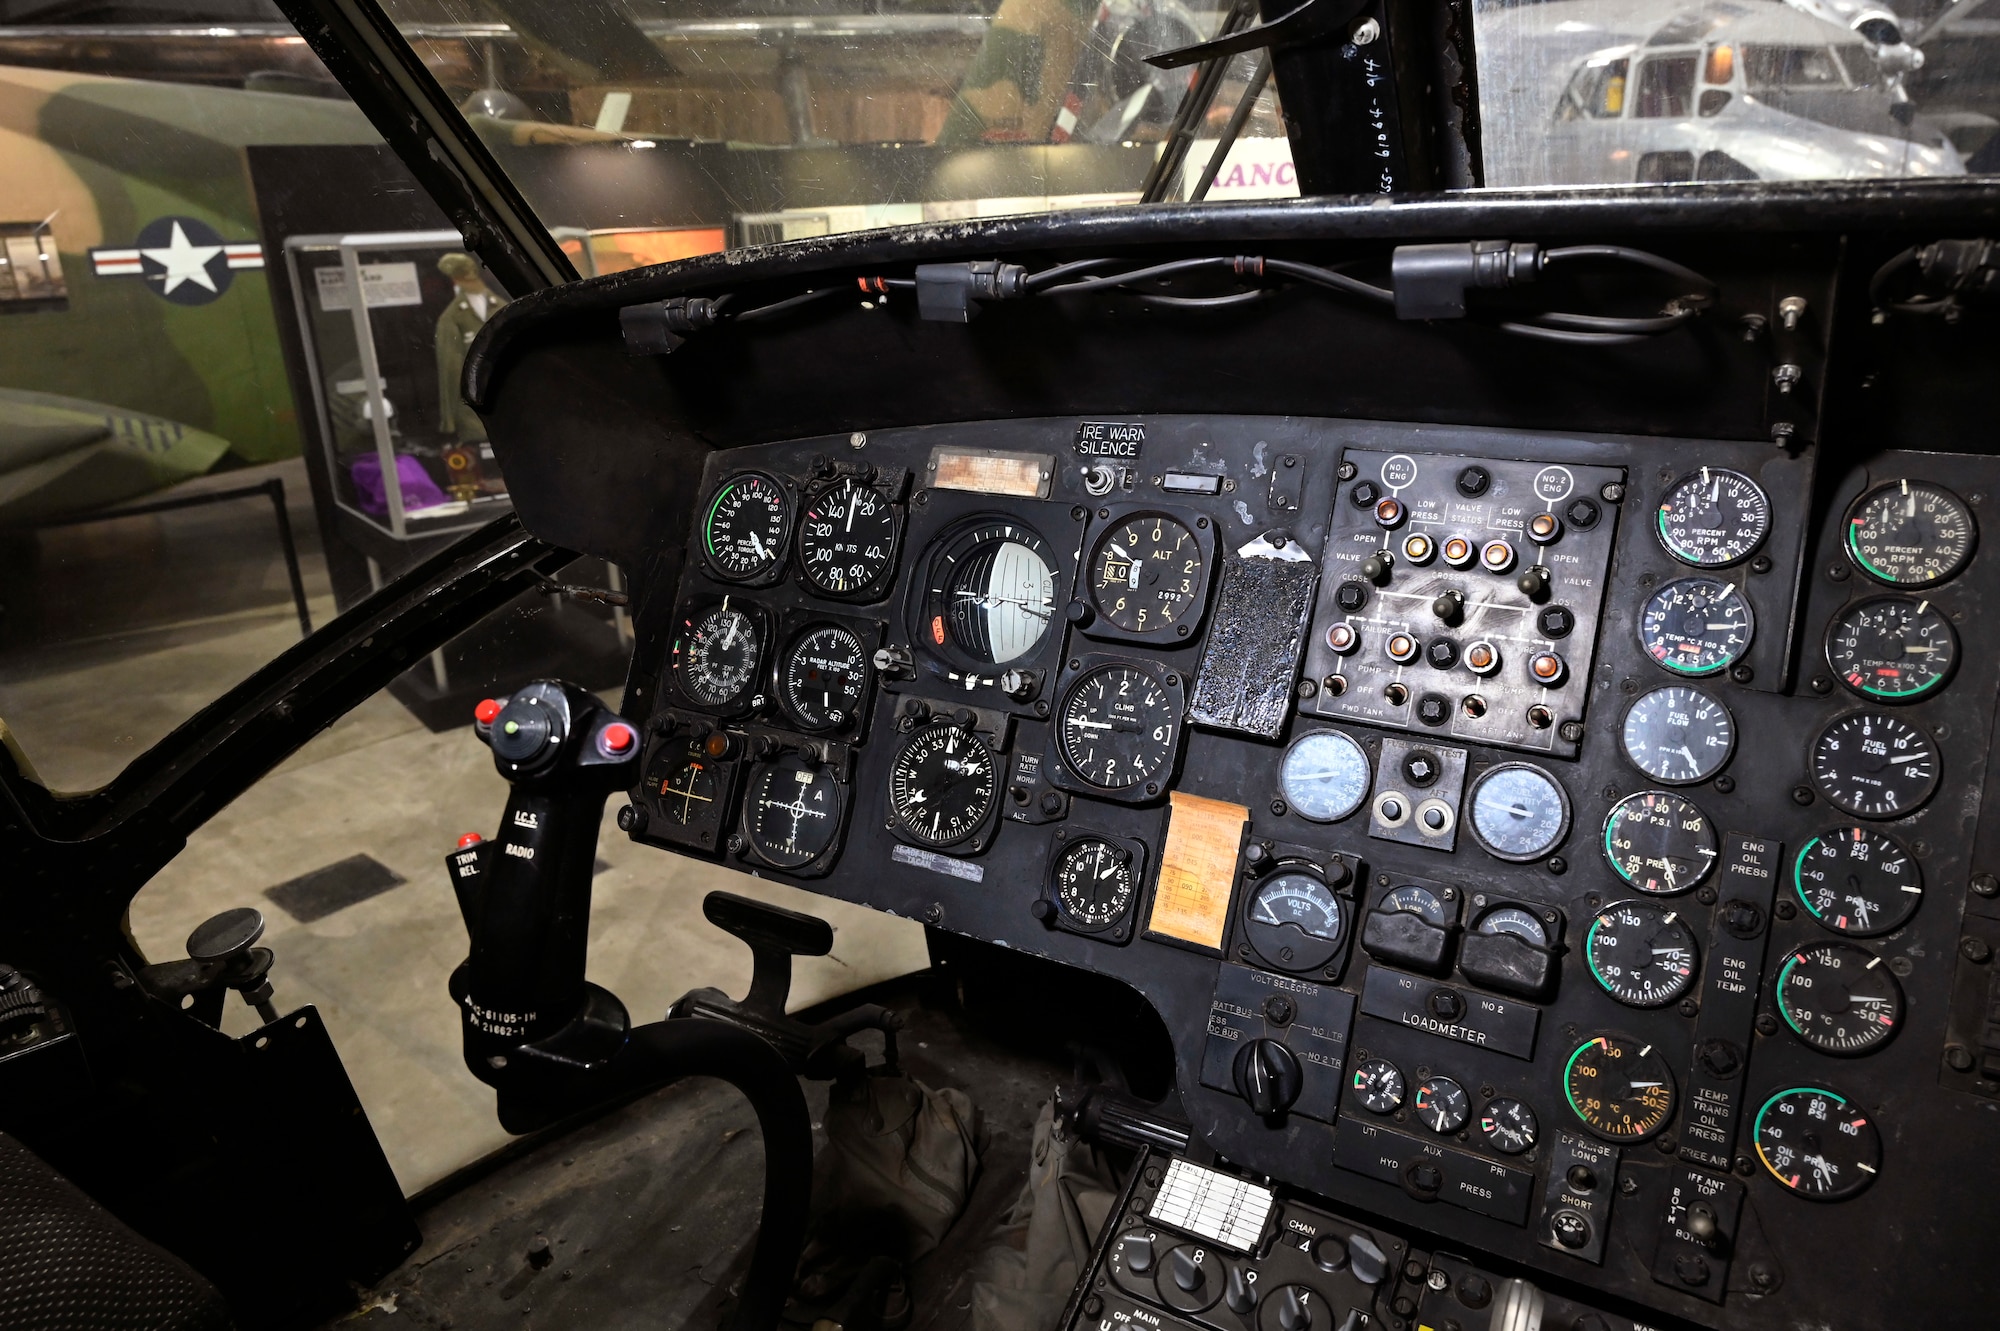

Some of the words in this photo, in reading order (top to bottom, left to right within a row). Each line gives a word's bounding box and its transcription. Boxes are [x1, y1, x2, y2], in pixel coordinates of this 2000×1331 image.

[1201, 162, 1294, 187] ANC
[1080, 426, 1103, 439] IRE
[1110, 427, 1145, 442] WARN
[1080, 441, 1137, 456] SILENCE
[1390, 471, 1406, 480] ENG
[1543, 484, 1562, 492] ENG
[829, 506, 844, 518] 140
[860, 503, 874, 515] 20
[1455, 504, 1482, 512] VALVE
[1502, 507, 1521, 516] LOW
[1411, 511, 1438, 520] PRESS
[1452, 514, 1482, 524] STATUS
[1496, 519, 1524, 528] PRESS
[816, 524, 832, 536] 120
[1859, 531, 1877, 539] 100
[1354, 535, 1376, 543] OPEN
[1696, 537, 1719, 546] RPM
[815, 549, 832, 561] 100
[865, 548, 879, 559] 40
[1152, 551, 1172, 560] ALT
[1884, 546, 1923, 554] PERCENT
[1336, 553, 1361, 561] VALVE
[1553, 554, 1578, 563] OPEN
[1891, 555, 1914, 563] RPM
[829, 567, 843, 579] 80
[850, 565, 864, 577] 60
[1342, 574, 1368, 582] CLOSE
[1563, 578, 1592, 587] VALVE
[1158, 592, 1181, 601] 2992
[1361, 625, 1392, 635] FAILURE
[809, 657, 826, 666] RADAR
[828, 660, 850, 670] ALTITUDE
[1357, 686, 1374, 694] OFF
[752, 696, 765, 707] BRT
[1115, 702, 1134, 712] CLIMB
[1342, 705, 1358, 713] FWD
[1362, 708, 1384, 716] TANK
[1670, 711, 1689, 720] FUEL
[829, 712, 842, 723] SET
[1667, 718, 1689, 726] FLOW
[1084, 732, 1099, 740] DOWN
[932, 739, 944, 750] 33
[1864, 739, 1887, 750] FUEL
[916, 749, 929, 763] 30
[1862, 745, 1887, 756] FLOW
[1021, 755, 1039, 764] TURN
[1019, 762, 1037, 771] RATE
[1106, 760, 1116, 774] 2
[796, 773, 811, 782] OFF
[909, 770, 917, 779] W
[1905, 767, 1917, 778] 12
[1016, 775, 1036, 785] NORM
[814, 790, 823, 801] A
[976, 787, 985, 795] E
[1430, 789, 1448, 797] AFT
[1512, 787, 1533, 797] FUEL
[916, 807, 927, 819] 21
[1012, 812, 1027, 820] ALT
[1650, 817, 1671, 827] P.S.I.
[1682, 820, 1700, 831] 100
[505, 843, 534, 859] RADIO
[1742, 842, 1765, 852] ENG
[1853, 843, 1868, 853] 80
[456, 851, 478, 866] TRIM
[1629, 855, 1643, 864] OIL
[1743, 854, 1760, 864] OIL
[1850, 851, 1869, 861] PSI
[459, 865, 480, 877] REL.
[1731, 864, 1768, 878] PRESS
[1881, 862, 1900, 874] 100
[1809, 870, 1824, 881] 40
[1182, 883, 1192, 891] 090
[1819, 888, 1836, 899] OIL
[1288, 898, 1311, 911] VOLTS
[1816, 896, 1831, 908] 20
[1405, 905, 1422, 913] LOAD
[1622, 915, 1640, 926] 150
[1599, 935, 1617, 946] 100
[1656, 961, 1677, 972] -50
[1723, 957, 1746, 969] ENG
[1820, 956, 1841, 969] 150
[1607, 967, 1621, 977] 50
[1630, 970, 1641, 980] °C
[1724, 970, 1741, 980] OIL
[1251, 973, 1271, 985] VOLT
[1274, 979, 1318, 997] SELECTOR
[1716, 980, 1746, 993] TEMP
[1791, 974, 1812, 988] 100
[1213, 1001, 1234, 1011] BATT
[1236, 1007, 1252, 1017] BUS
[1482, 1001, 1495, 1012] NO
[1497, 1005, 1504, 1014] 2
[1212, 1015, 1227, 1025] ESS
[1795, 1008, 1812, 1021] 50
[1821, 1014, 1832, 1025] °C
[1853, 1009, 1877, 1022] -50
[1209, 1024, 1220, 1034] DC
[1222, 1028, 1238, 1038] BUS
[1402, 1012, 1486, 1044] LOADMETER
[1308, 1052, 1320, 1061] NO
[1330, 1057, 1341, 1067] TR
[1579, 1065, 1597, 1077] 100
[1699, 1088, 1729, 1102] TEMP
[1635, 1096, 1656, 1107] -50
[1810, 1099, 1826, 1112] 80
[1609, 1104, 1620, 1113] °C
[1694, 1101, 1729, 1118] TRANS
[1779, 1103, 1795, 1115] 60
[1808, 1108, 1827, 1121] PSI
[1701, 1114, 1718, 1127] OIL
[1767, 1127, 1782, 1138] 40
[1839, 1121, 1858, 1136] 100
[1688, 1127, 1725, 1143] PRESS
[1423, 1145, 1442, 1157] AUX
[1571, 1149, 1597, 1162] LONG
[1777, 1145, 1795, 1159] OIL
[1680, 1147, 1707, 1162] FREE
[1711, 1154, 1728, 1167] AIR
[1774, 1154, 1790, 1167] 20
[1490, 1166, 1506, 1177] PRI
[1380, 1157, 1398, 1169] HYD
[1460, 1182, 1492, 1199] PRESS
[1688, 1172, 1703, 1185] IFF
[1706, 1178, 1725, 1191] ANT
[1698, 1184, 1716, 1196] TOP
[1561, 1194, 1592, 1210] SHORT
[1289, 1219, 1316, 1235] CHAN
[1300, 1239, 1311, 1252] 4
[1193, 1250, 1204, 1263] 8
[1247, 1272, 1257, 1284] 9
[1299, 1292, 1309, 1305] 4
[1114, 1312, 1131, 1323] OFF
[1133, 1310, 1160, 1326] MAIN
[1100, 1320, 1112, 1331] U
